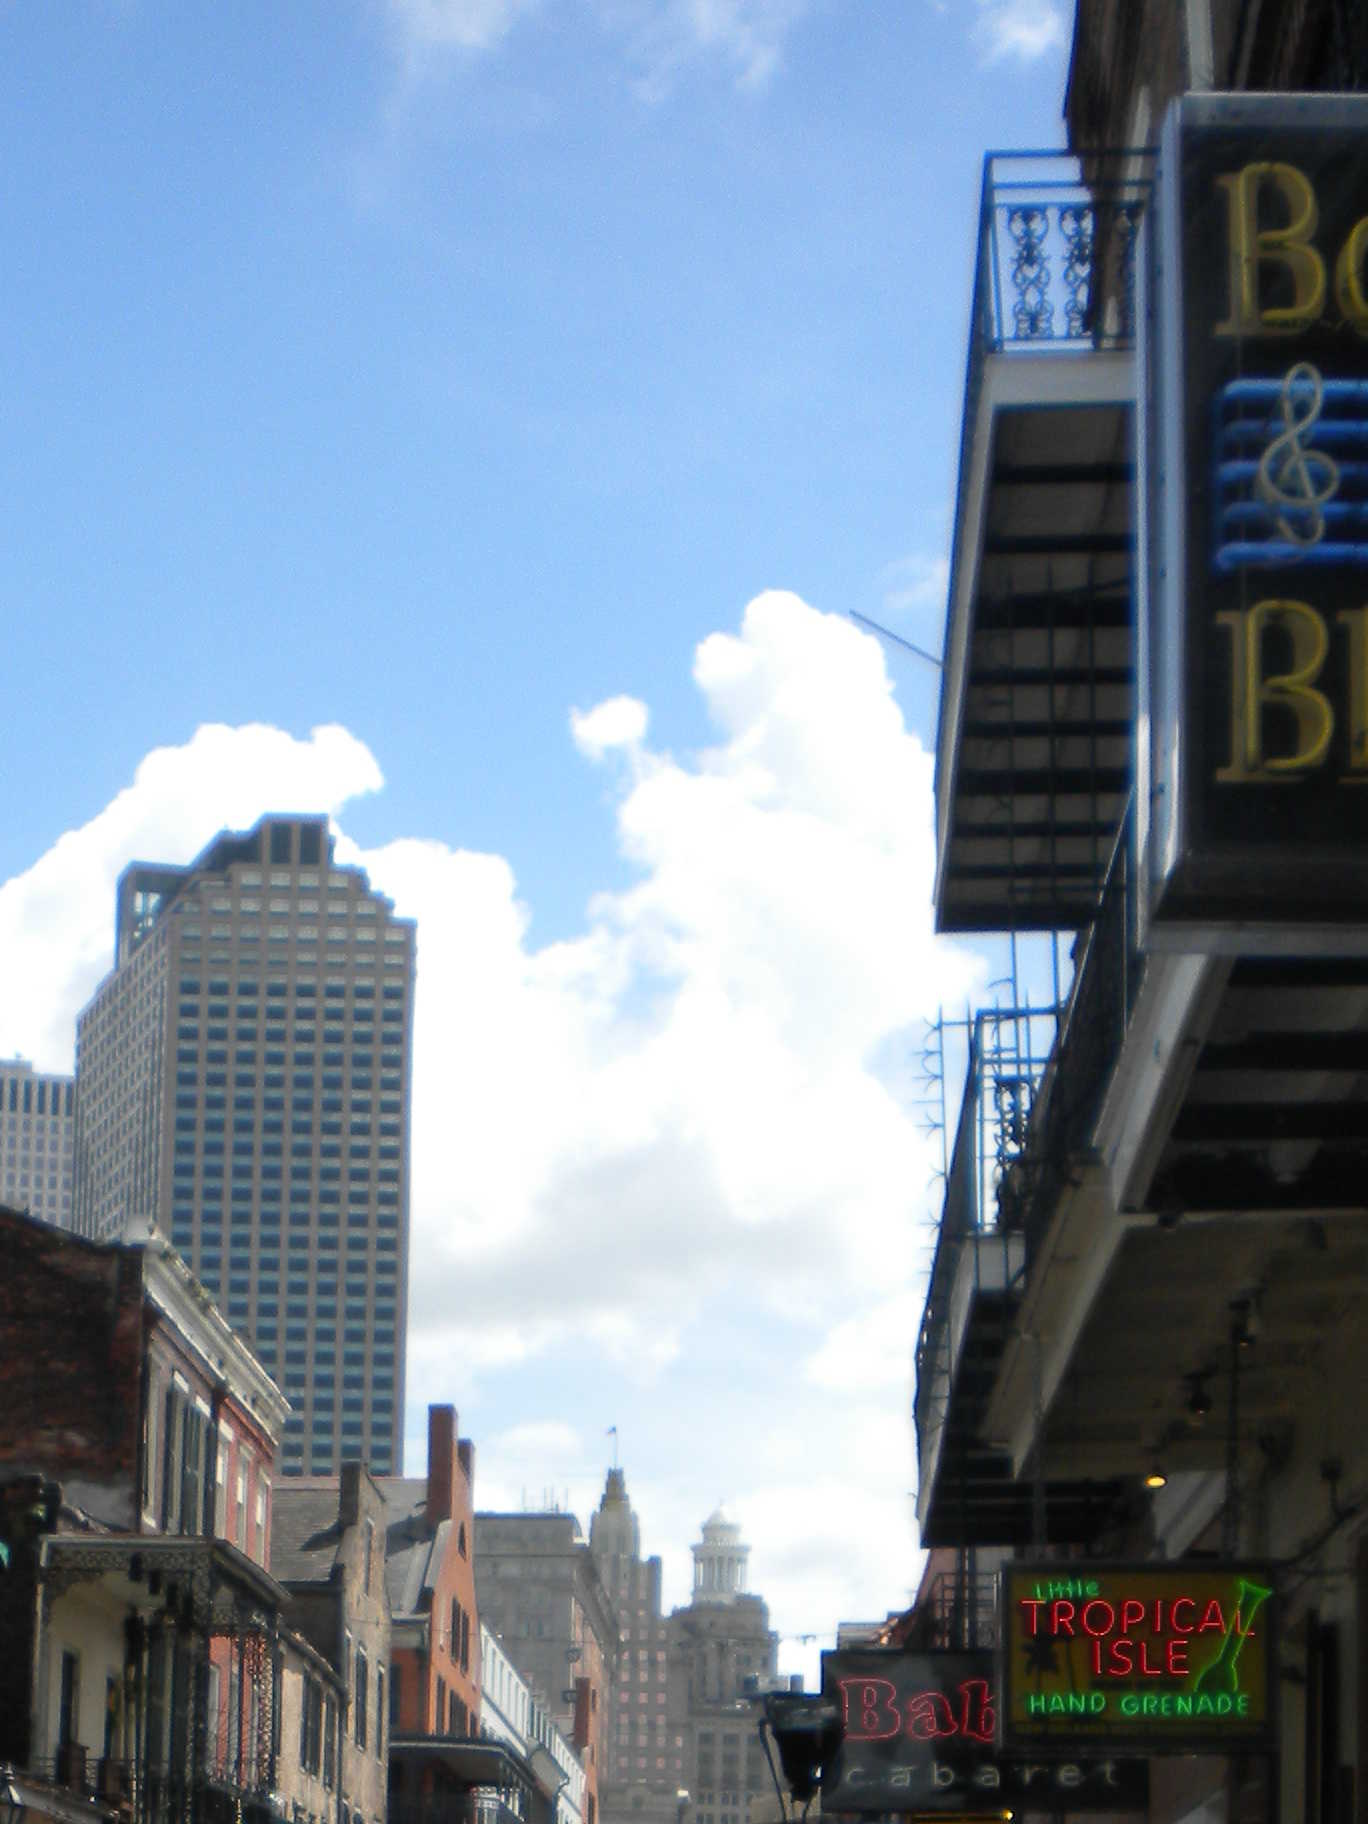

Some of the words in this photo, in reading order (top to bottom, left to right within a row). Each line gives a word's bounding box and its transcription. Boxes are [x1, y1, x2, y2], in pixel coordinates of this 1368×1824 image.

[1019, 1597, 1257, 1637] TROPICAL
[1093, 1638, 1190, 1676] ISLE
[1028, 1693, 1107, 1716] HAND
[1119, 1693, 1250, 1717] GRENADE
[844, 1761, 1120, 1788] cabaret
